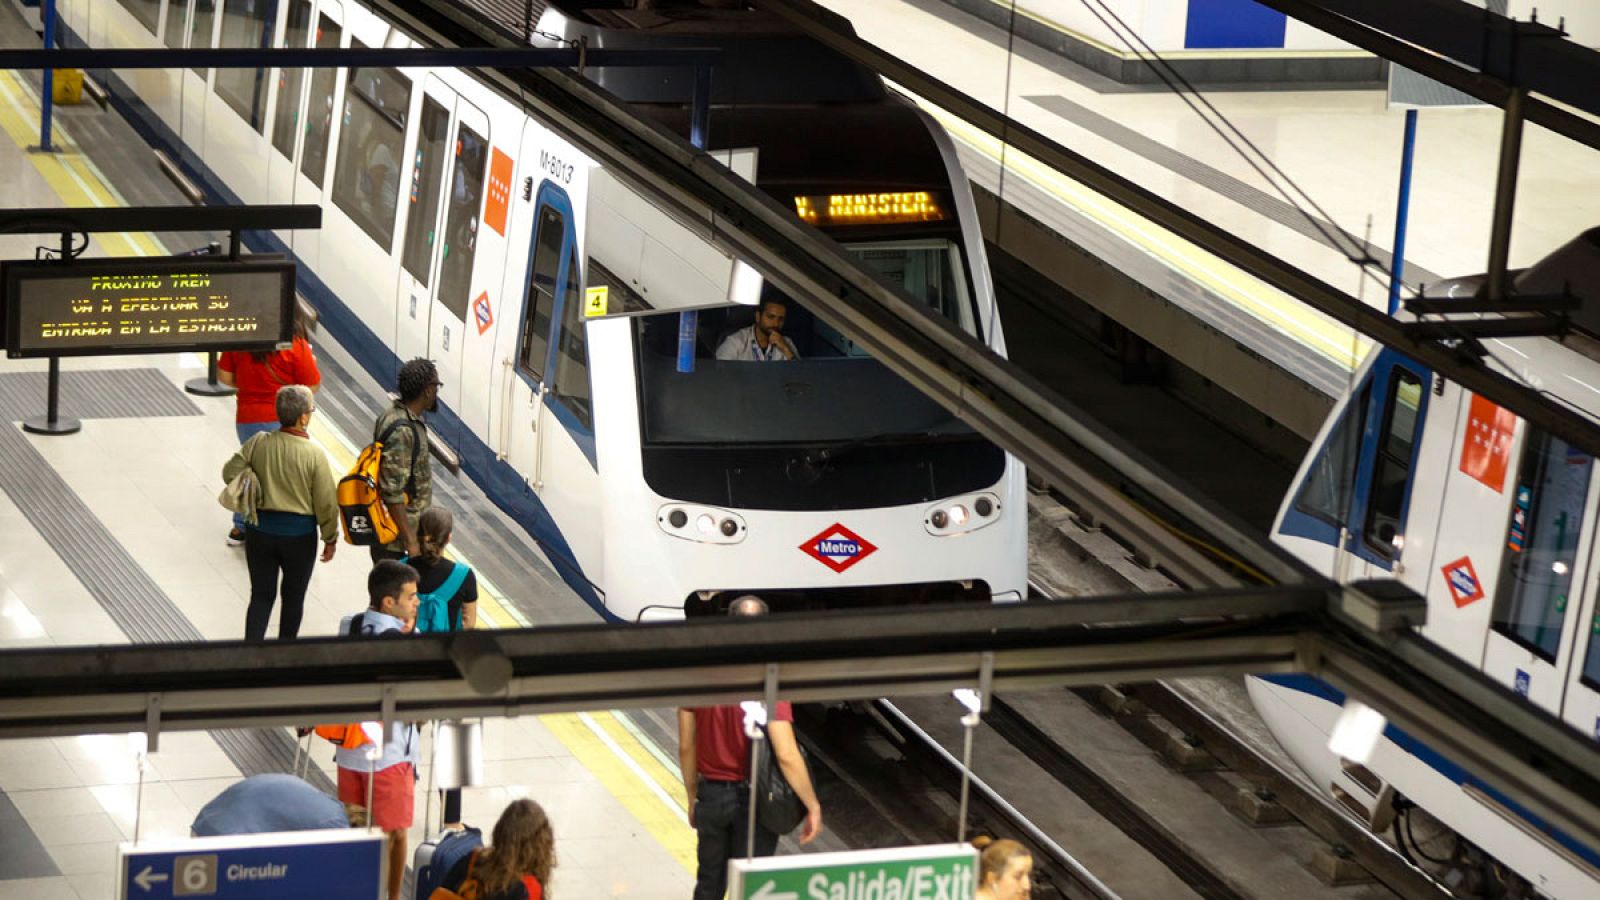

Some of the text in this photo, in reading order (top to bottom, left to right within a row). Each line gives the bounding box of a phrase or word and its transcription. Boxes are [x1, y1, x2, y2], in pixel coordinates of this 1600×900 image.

[540, 149, 574, 184] M-8013
[170, 273, 211, 288] TREN
[101, 298, 112, 313] A
[120, 296, 199, 312] EFECTUAR
[591, 295, 601, 309] 4
[41, 321, 112, 338] ENTRADA
[120, 320, 141, 335] EN
[820, 541, 857, 553] Metro
[183, 859, 289, 891] 6 Circular
[808, 863, 972, 900] Salida/Exit
